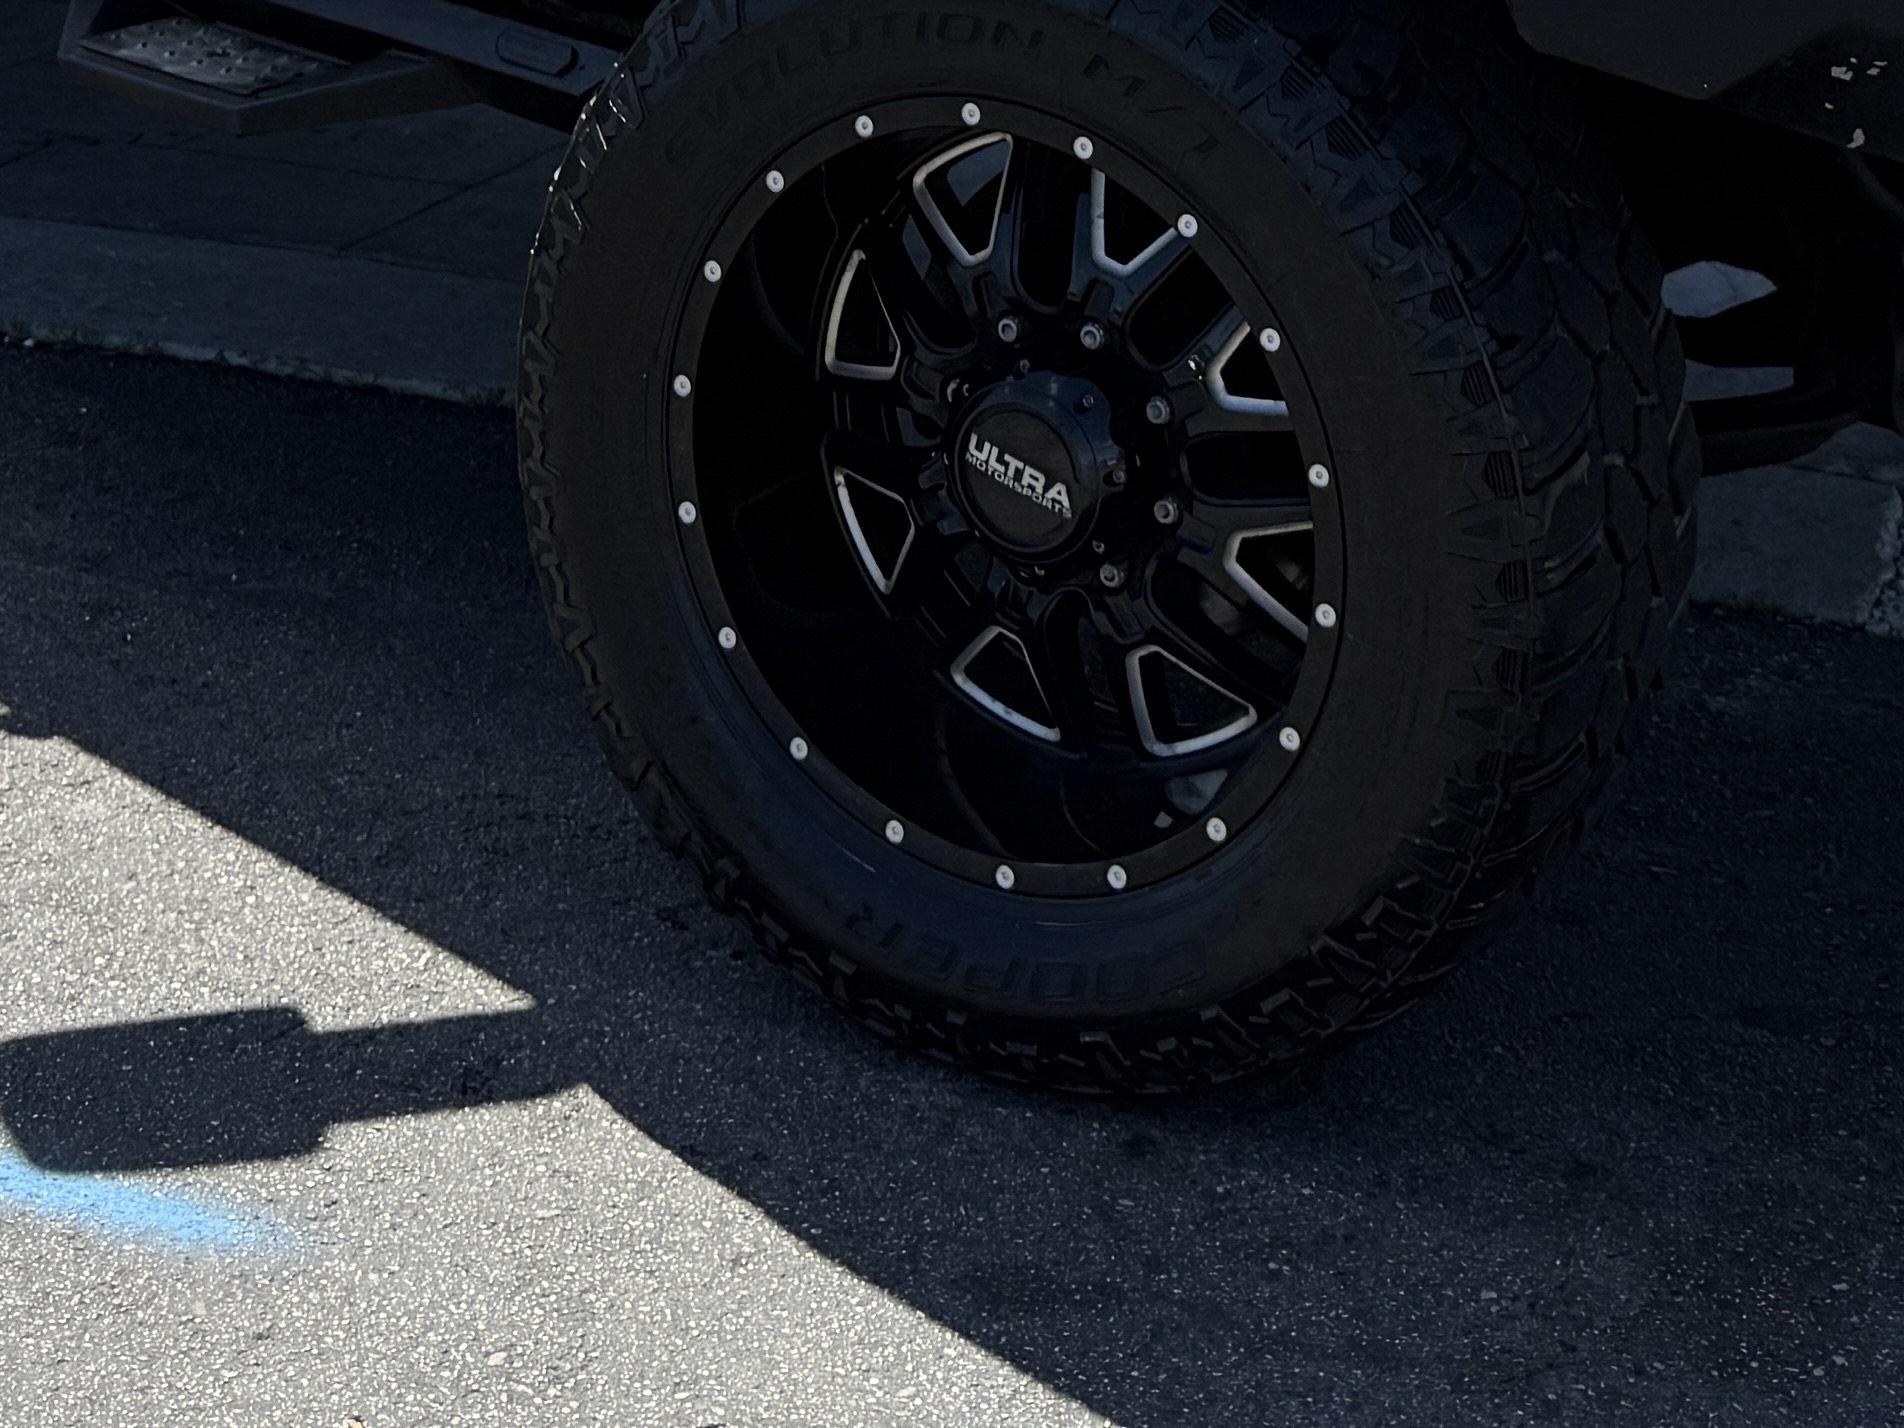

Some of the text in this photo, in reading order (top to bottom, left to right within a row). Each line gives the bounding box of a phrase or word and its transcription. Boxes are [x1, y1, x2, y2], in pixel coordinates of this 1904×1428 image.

[664, 9, 1045, 170] EVOLUTION
[965, 452, 1073, 519] MOTORSPORTS
[968, 432, 1072, 511] ULTRA
